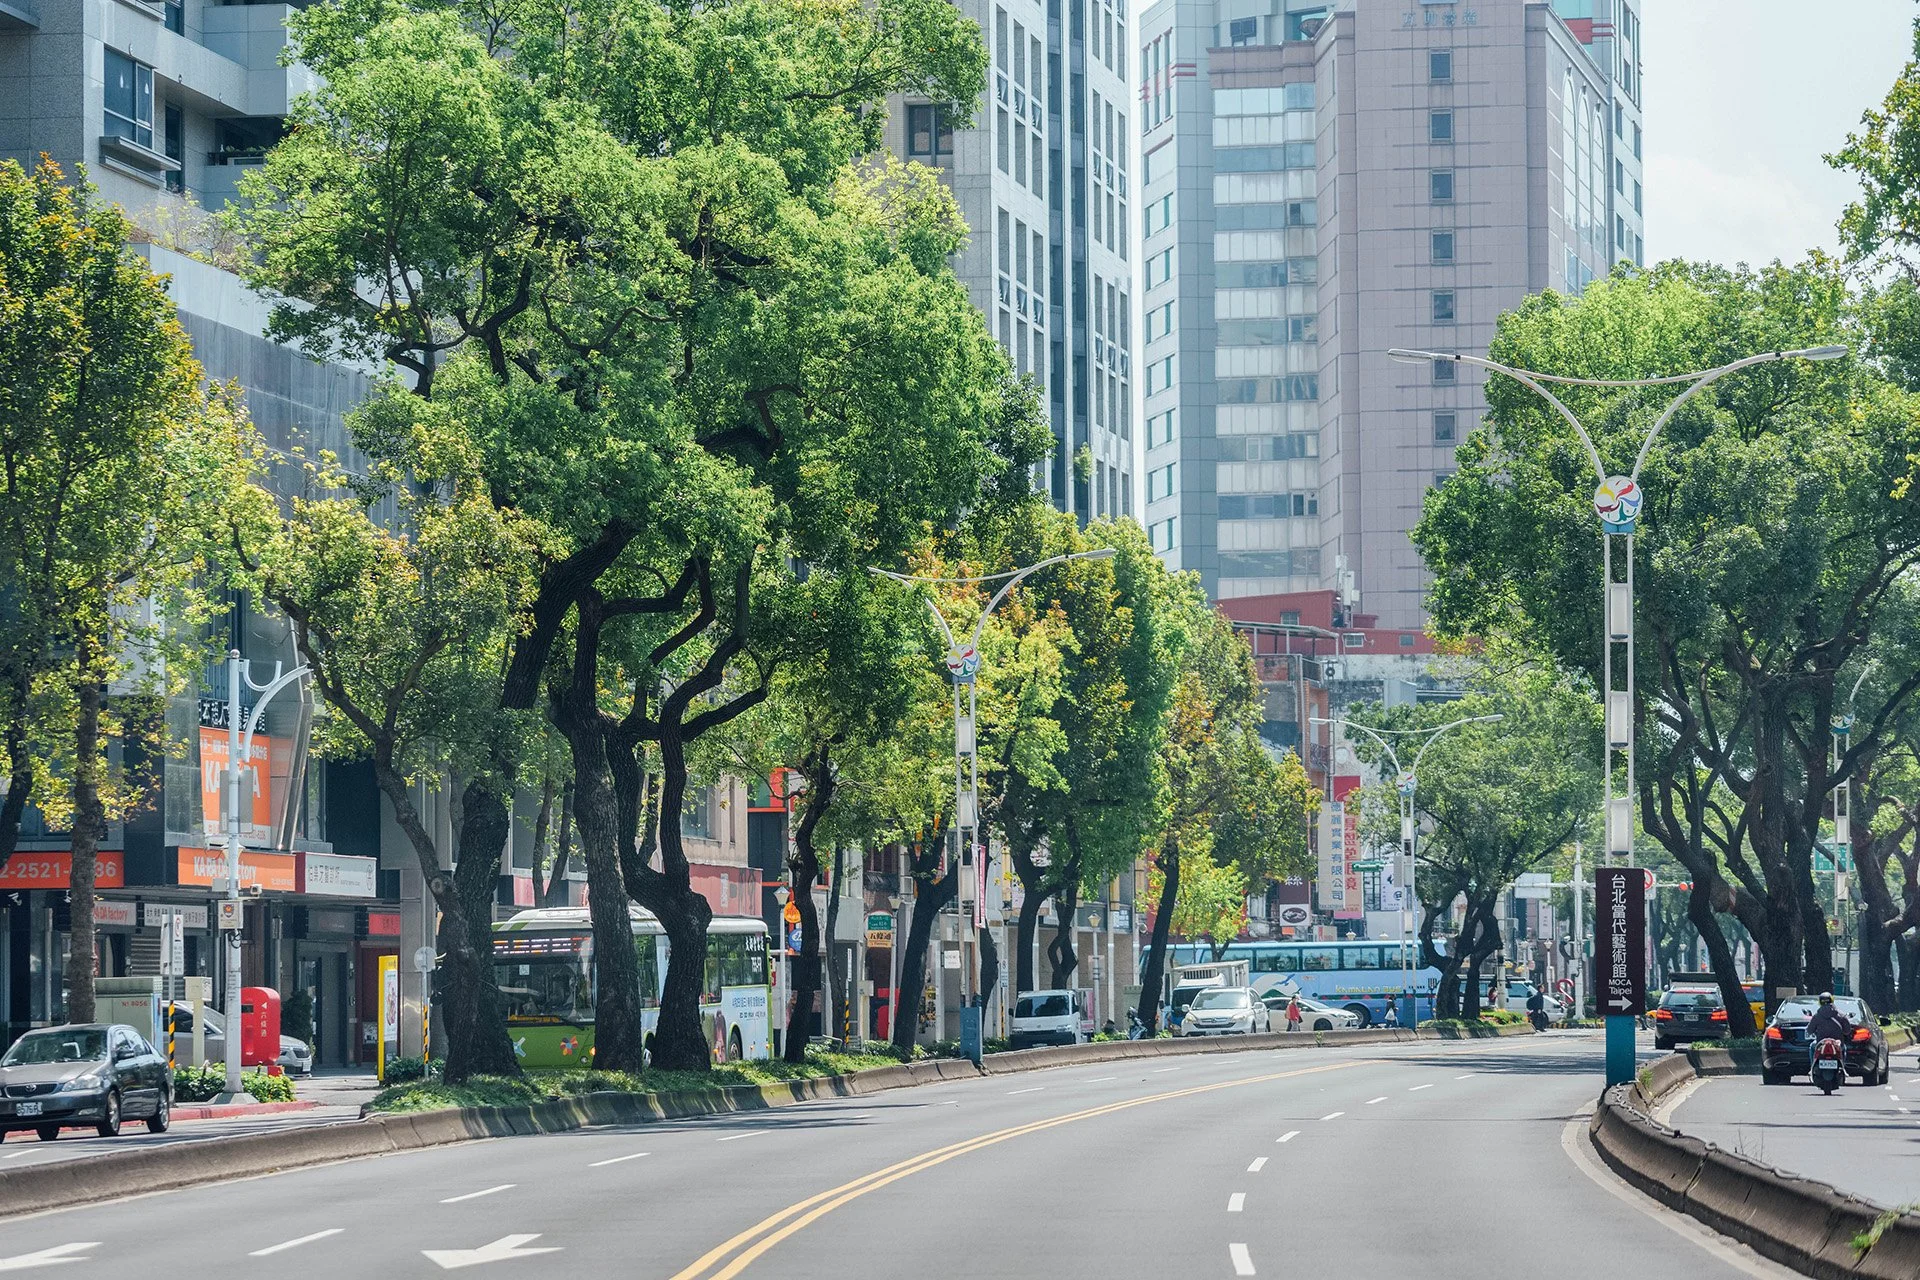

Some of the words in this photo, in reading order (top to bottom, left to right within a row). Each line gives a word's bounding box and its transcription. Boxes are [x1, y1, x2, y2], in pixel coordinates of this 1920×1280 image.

[1611, 874, 1627, 979] 台北當代藝術館
[1609, 986, 1633, 996] Taipei
